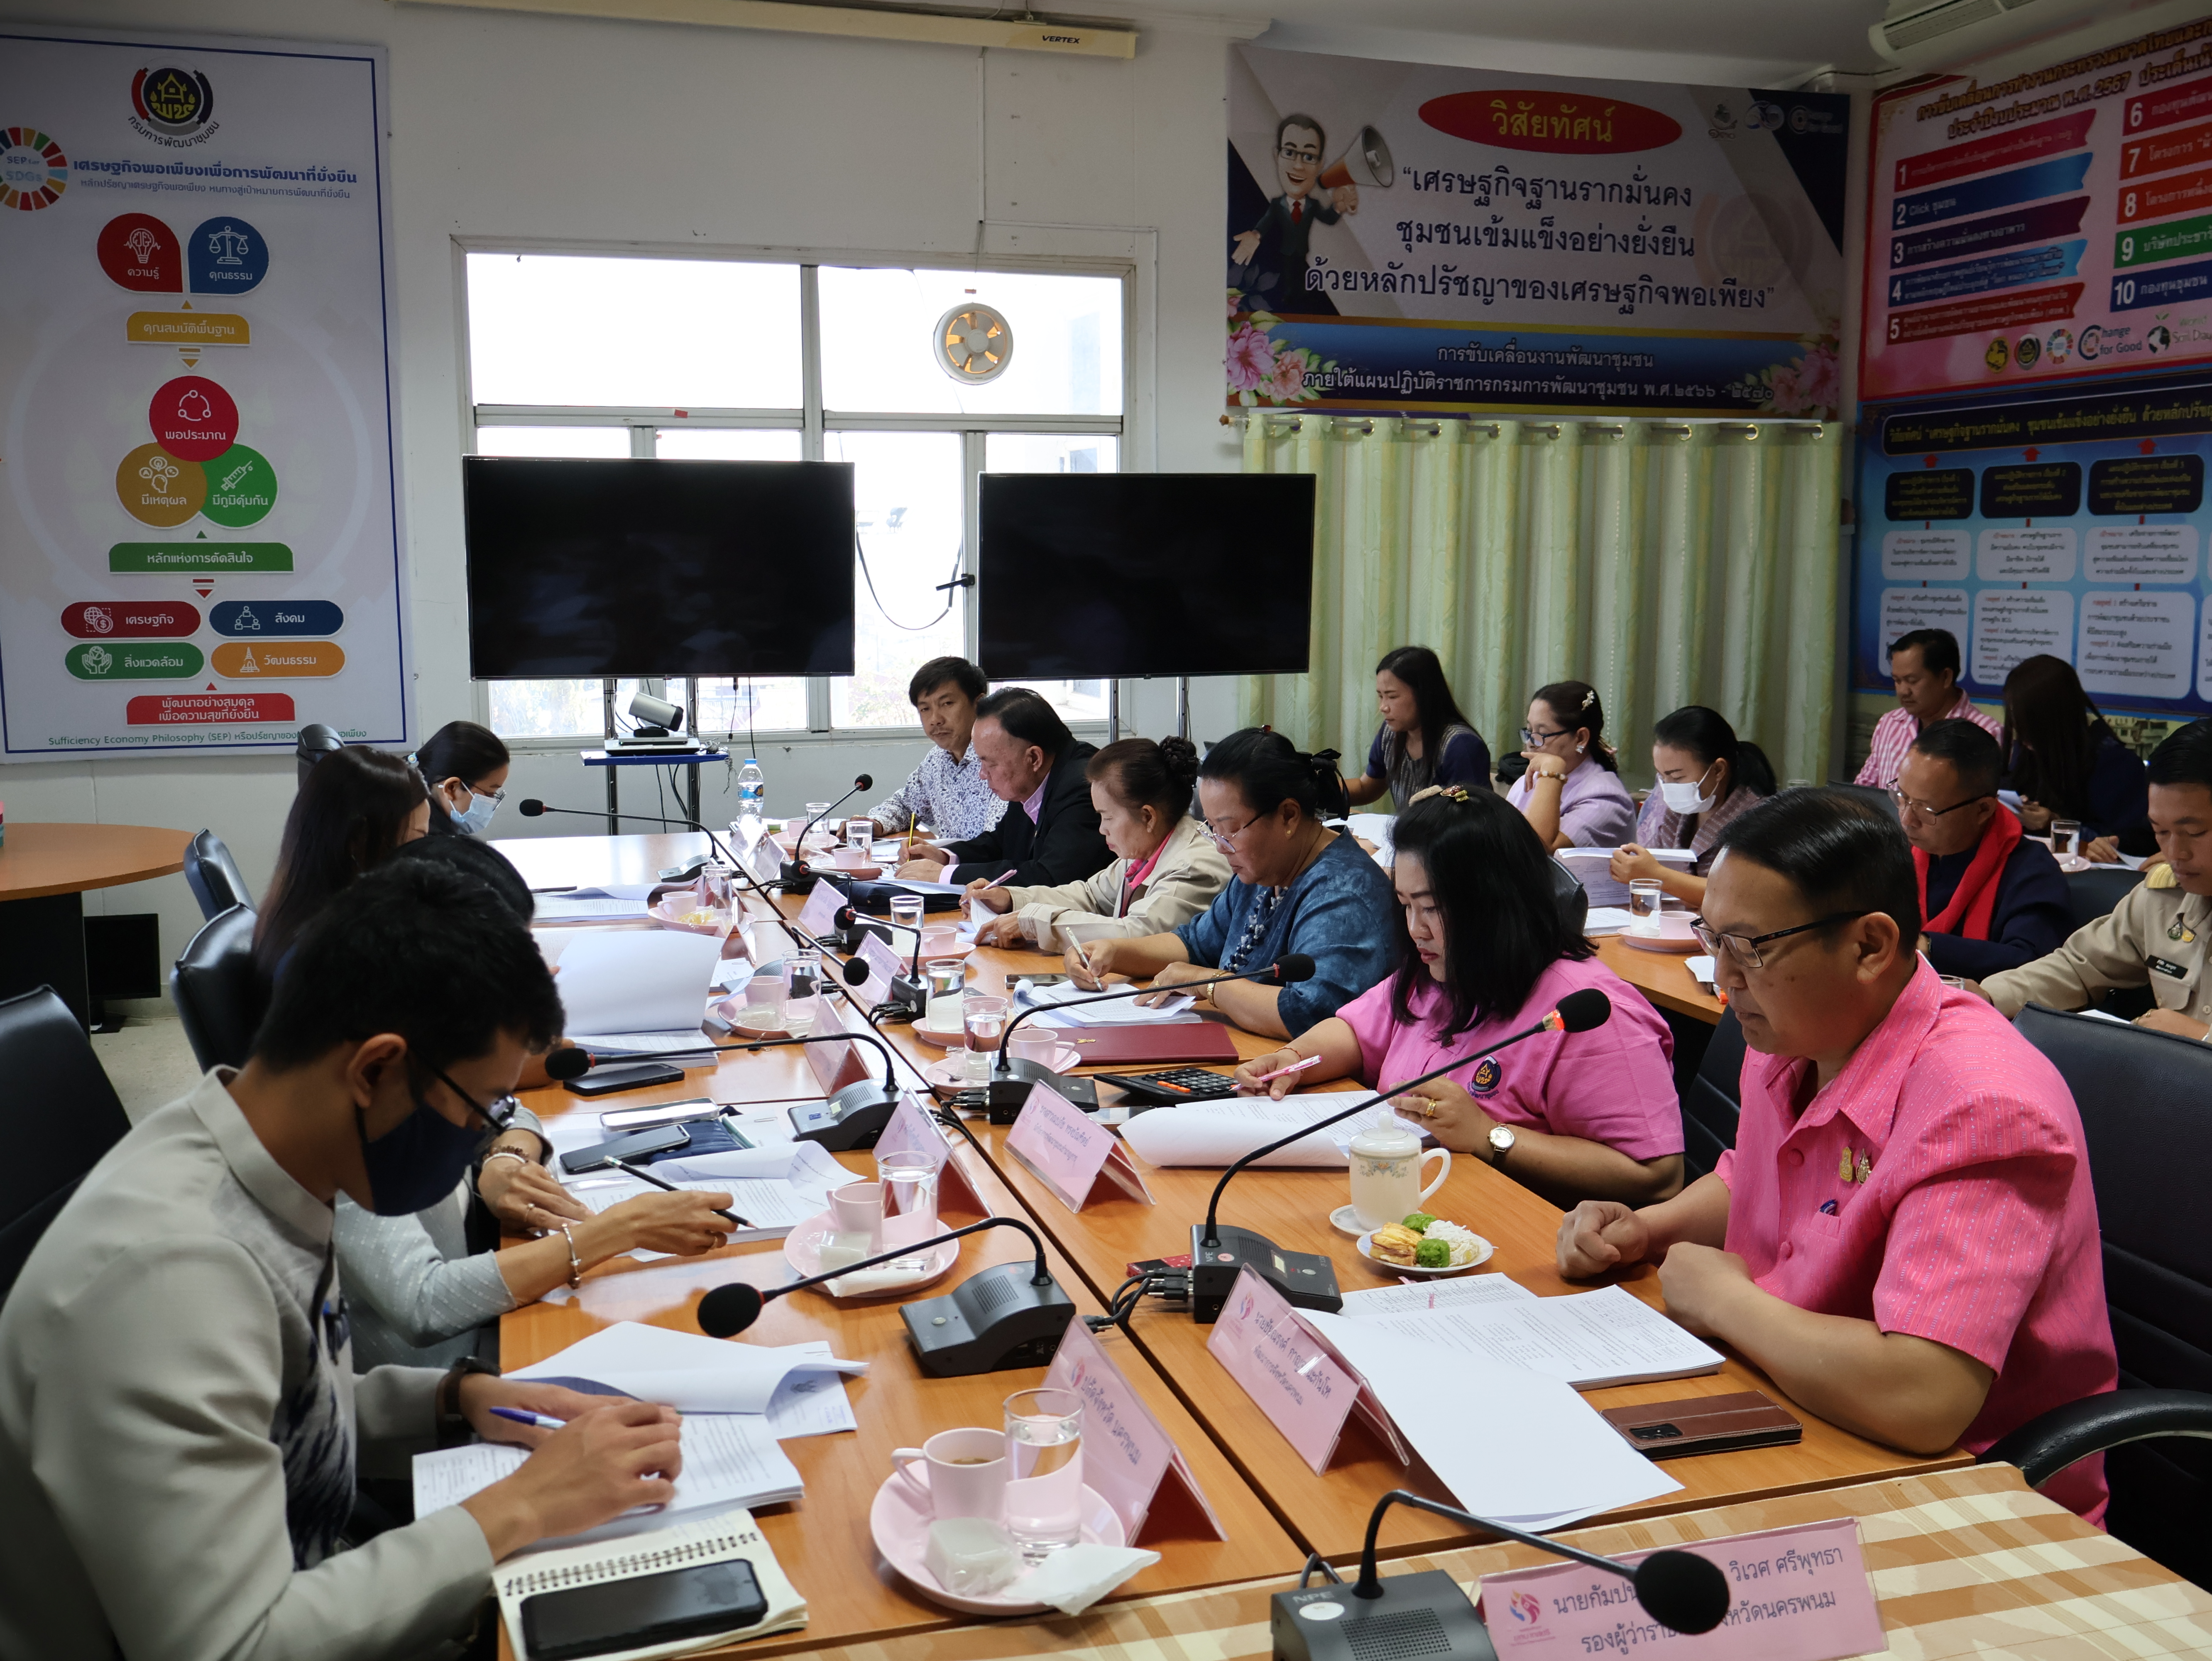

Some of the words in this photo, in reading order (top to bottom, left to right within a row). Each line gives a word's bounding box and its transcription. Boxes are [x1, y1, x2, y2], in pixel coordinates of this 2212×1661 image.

[1042, 35, 1080, 44] VERTEX
[1490, 99, 1615, 142] วิสัยทัศน์
[2129, 102, 2143, 127] 6
[128, 116, 220, 149] กรมการพัฒนาชุมชน
[7, 156, 27, 164] SEP
[2128, 148, 2141, 173] 7
[5, 170, 43, 183] SDGs
[73, 159, 357, 184] เศรษฐกิจพอเพียงเพื่อการพัฒนาที่ยั่งยืน
[1899, 164, 1907, 185] 1
[1403, 165, 1693, 210] “เศรษฐกิจฐานรากมั่นคง
[1910, 201, 1930, 217] Click
[2125, 192, 2136, 217] 8
[1896, 204, 1907, 225] 2
[1396, 214, 1696, 258] ชุมชนเข้มแข็งอย่างยั่งยืน
[1894, 242, 1904, 264] 3
[2121, 236, 2134, 262] 9
[127, 266, 160, 280] ความรู้
[209, 269, 253, 282] คุณธรรม
[1305, 256, 1775, 316] ด้วยหลักปรัชญาของเศรษฐกิจพอเพียง”
[1891, 280, 1902, 301] 4
[2114, 280, 2135, 305] 10
[143, 319, 235, 338] คุณสมบัติพื้นฐาน
[1889, 318, 1900, 340] 5
[1437, 338, 1654, 370] การขับเคลื่อนงานพัฒนาชุมชน
[2099, 343, 2113, 355] for
[2116, 339, 2143, 353] Good
[1302, 367, 1638, 398] ภายใต้แผนปฏิบัติราชการกรมการพัฒนาชุมชน
[165, 430, 226, 441] พอประมาณ
[141, 494, 187, 507] มีเหตุผล
[212, 494, 269, 509] มีภูมิคุ้มกัน
[147, 550, 254, 565] หลักแห่งการตัดสินใจ
[125, 612, 174, 626] เศรษฐกิจ
[275, 612, 305, 624] สังคม
[125, 655, 184, 668] สิ่งแวดล้อม
[264, 653, 317, 666] วัฒนธรรม
[161, 695, 255, 710] พัฒนาอย่างสมดุล
[159, 708, 260, 722] เพื่อความสุขที่ยั่งยืน
[48, 735, 100, 747] Sufficiency
[104, 735, 150, 745] Economy
[152, 733, 206, 744] Philosophy
[208, 731, 232, 742] (SEP)
[1205, 1251, 1214, 1262] NPE
[1775, 1546, 1844, 1579] ศรีพุทธา
[1292, 1591, 1334, 1604] NPE
